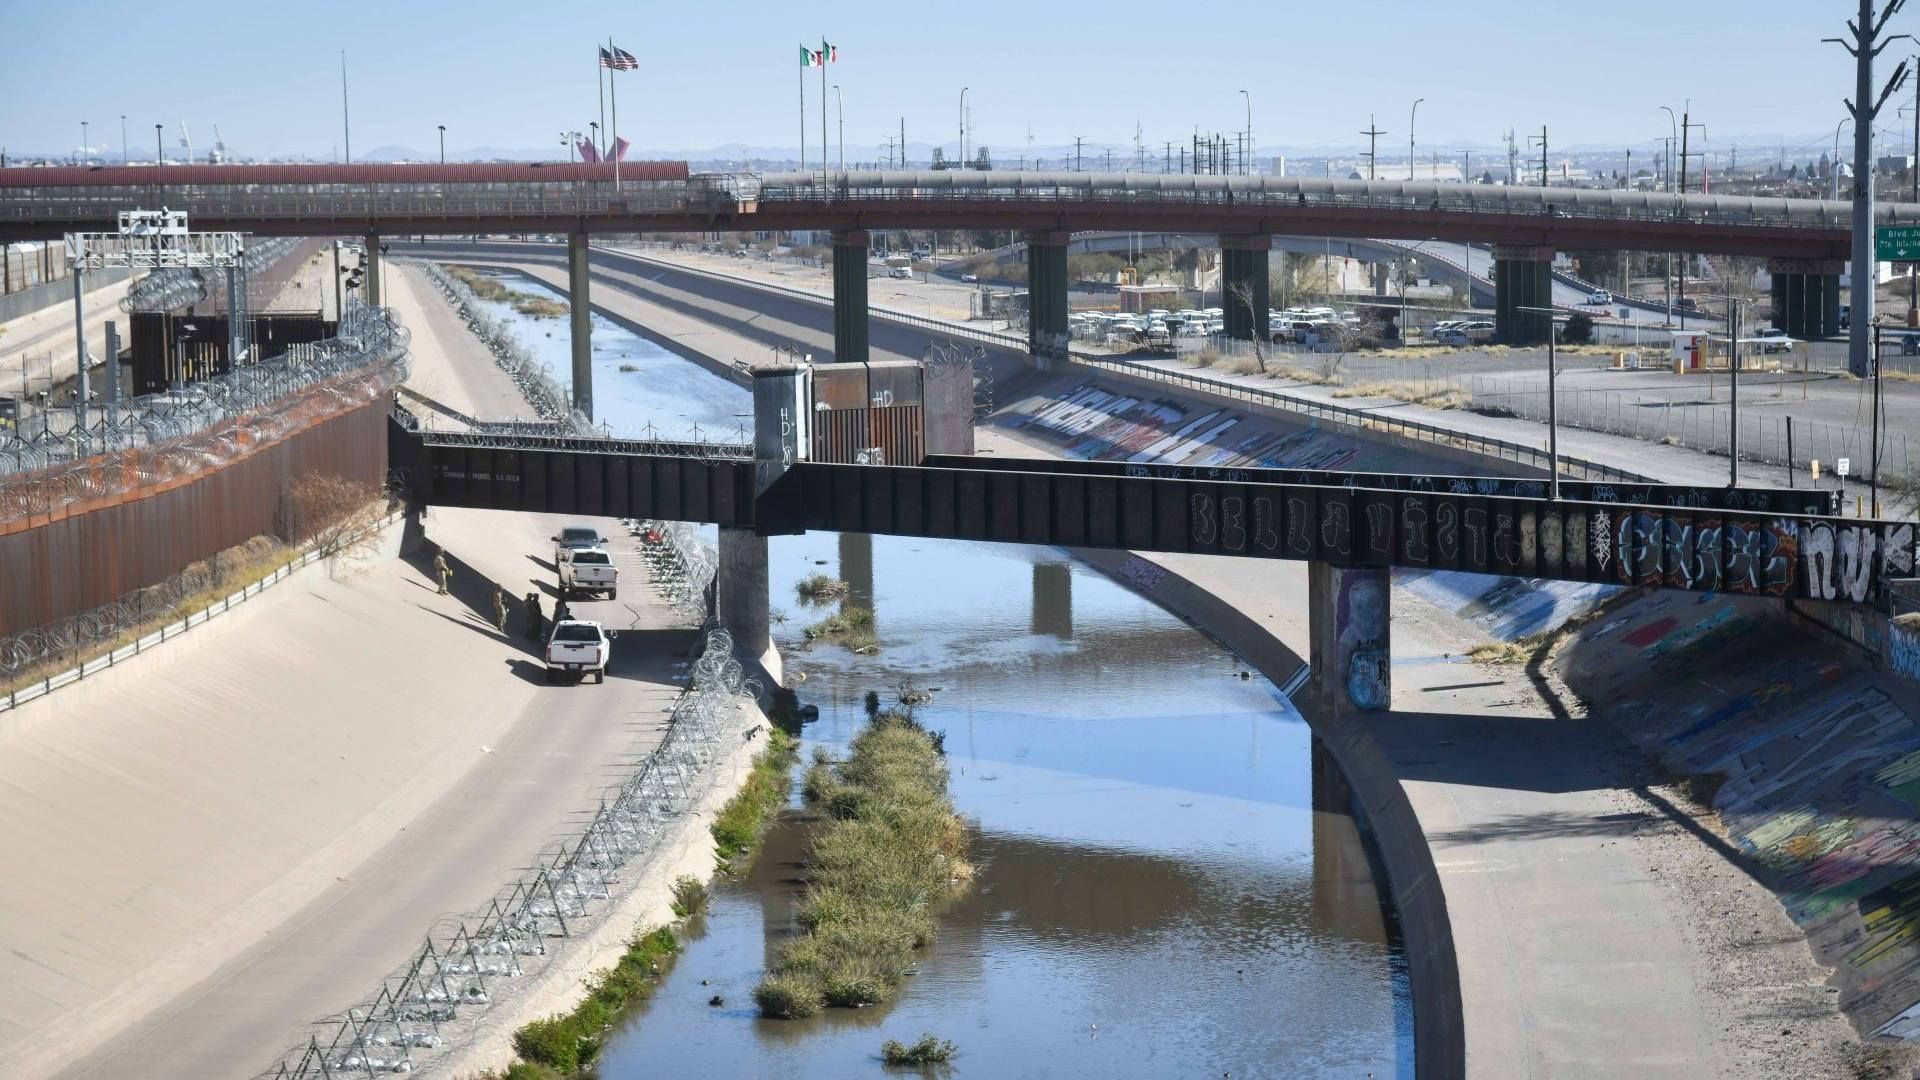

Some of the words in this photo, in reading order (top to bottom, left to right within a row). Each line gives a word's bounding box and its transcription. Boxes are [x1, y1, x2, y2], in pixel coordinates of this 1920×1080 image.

[1888, 230, 1906, 238] Blvd
[1191, 493, 1351, 554] BELLA
[1365, 498, 1521, 567] VISTA
